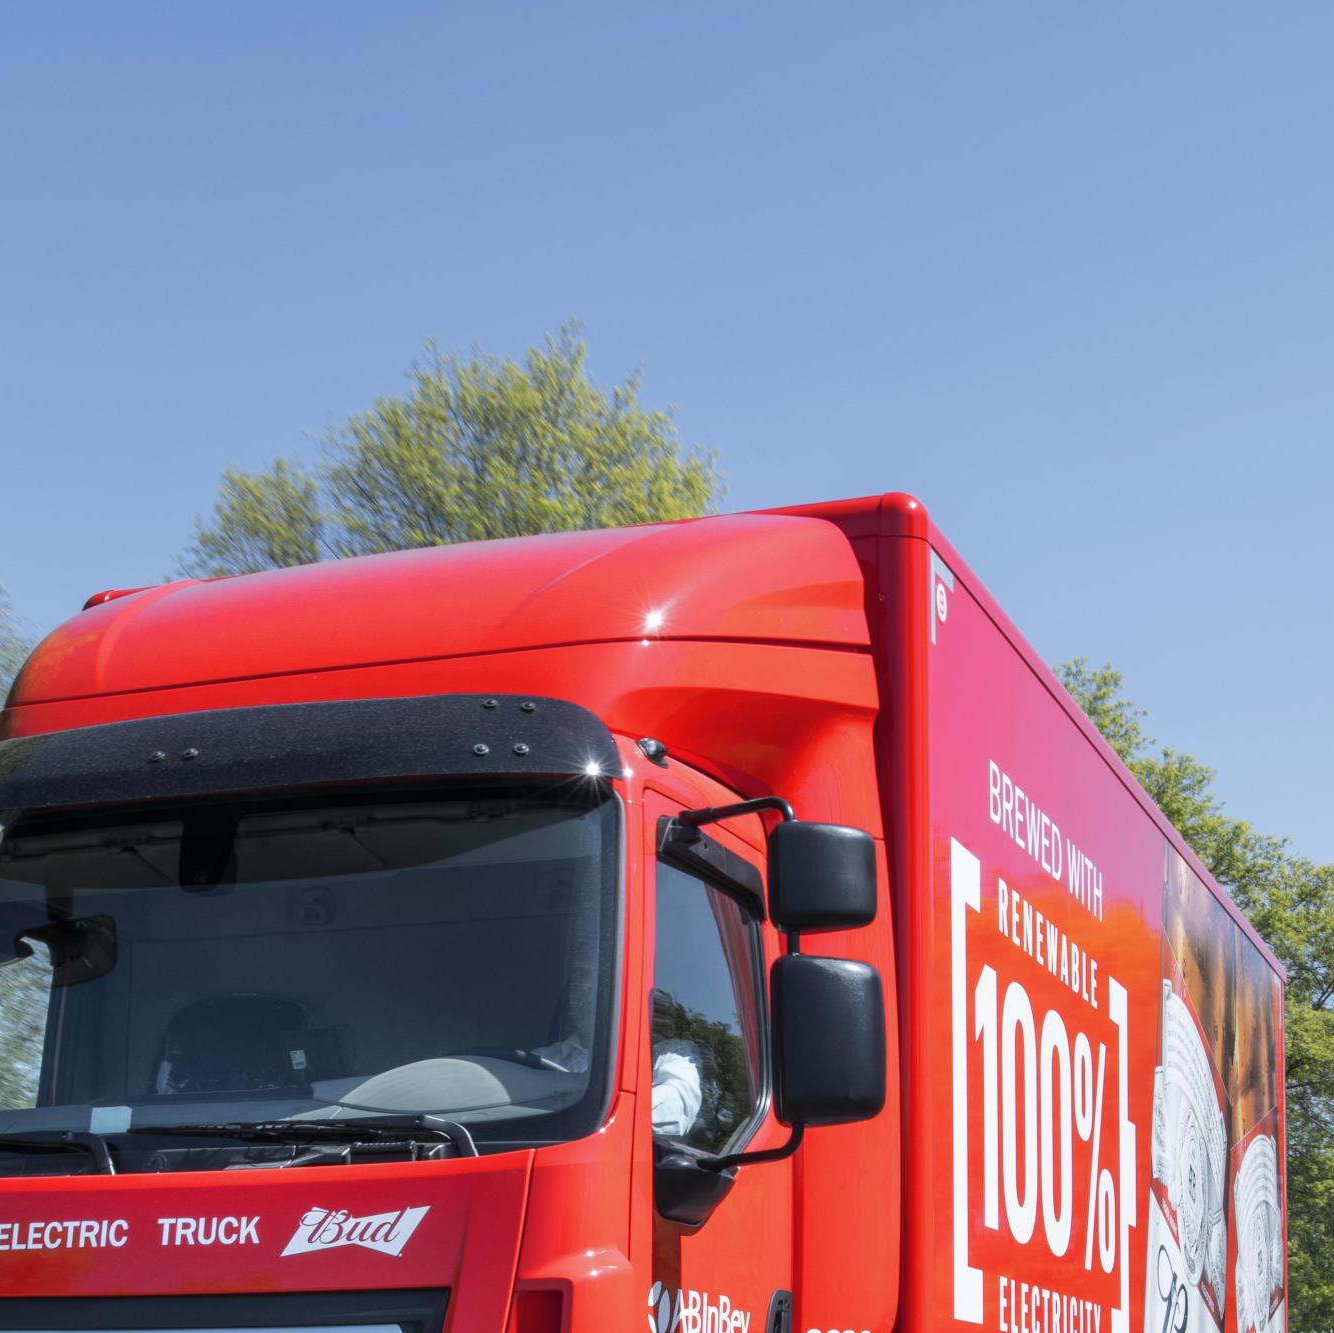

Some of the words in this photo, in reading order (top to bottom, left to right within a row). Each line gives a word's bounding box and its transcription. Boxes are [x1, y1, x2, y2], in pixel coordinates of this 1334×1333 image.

[989, 759, 1063, 881] BREWED
[1067, 838, 1103, 923] WITH
[998, 877, 1098, 1009] RENEWABLE
[975, 963, 1116, 1274] 100%
[157, 1216, 261, 1246] TRUCK
[301, 1207, 407, 1245] Bud
